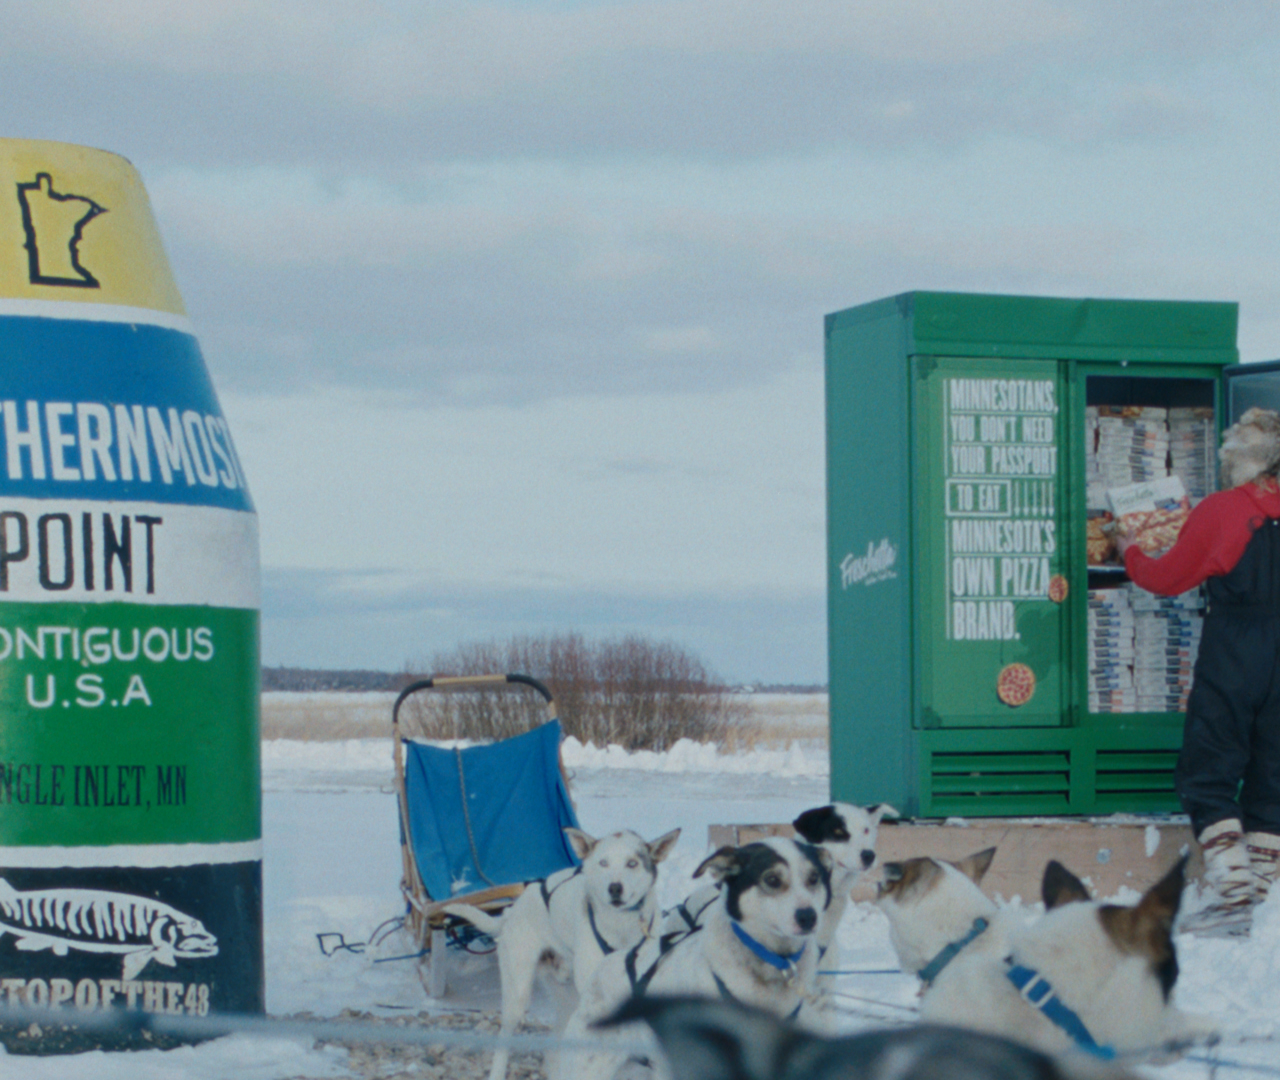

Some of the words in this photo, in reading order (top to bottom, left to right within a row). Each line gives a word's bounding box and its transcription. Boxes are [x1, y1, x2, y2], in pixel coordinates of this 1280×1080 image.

[950, 378, 1059, 414] MINNESOTANS,
[950, 415, 975, 442] YOU
[980, 415, 1017, 442] DON'T
[1022, 416, 1054, 443] NEED
[951, 445, 985, 474] YOUR
[991, 446, 1057, 475] PASSPORT
[957, 484, 973, 511] TO
[978, 484, 1000, 511] EAT
[952, 519, 1056, 553] MINNESOTA'S
[953, 557, 995, 596] OWN
[1001, 557, 1050, 596] PIZZA
[953, 601, 1021, 641] BRAND.
[26, 673, 152, 708] U.S.A
[72, 764, 151, 812] INLET,
[156, 764, 187, 806] MN
